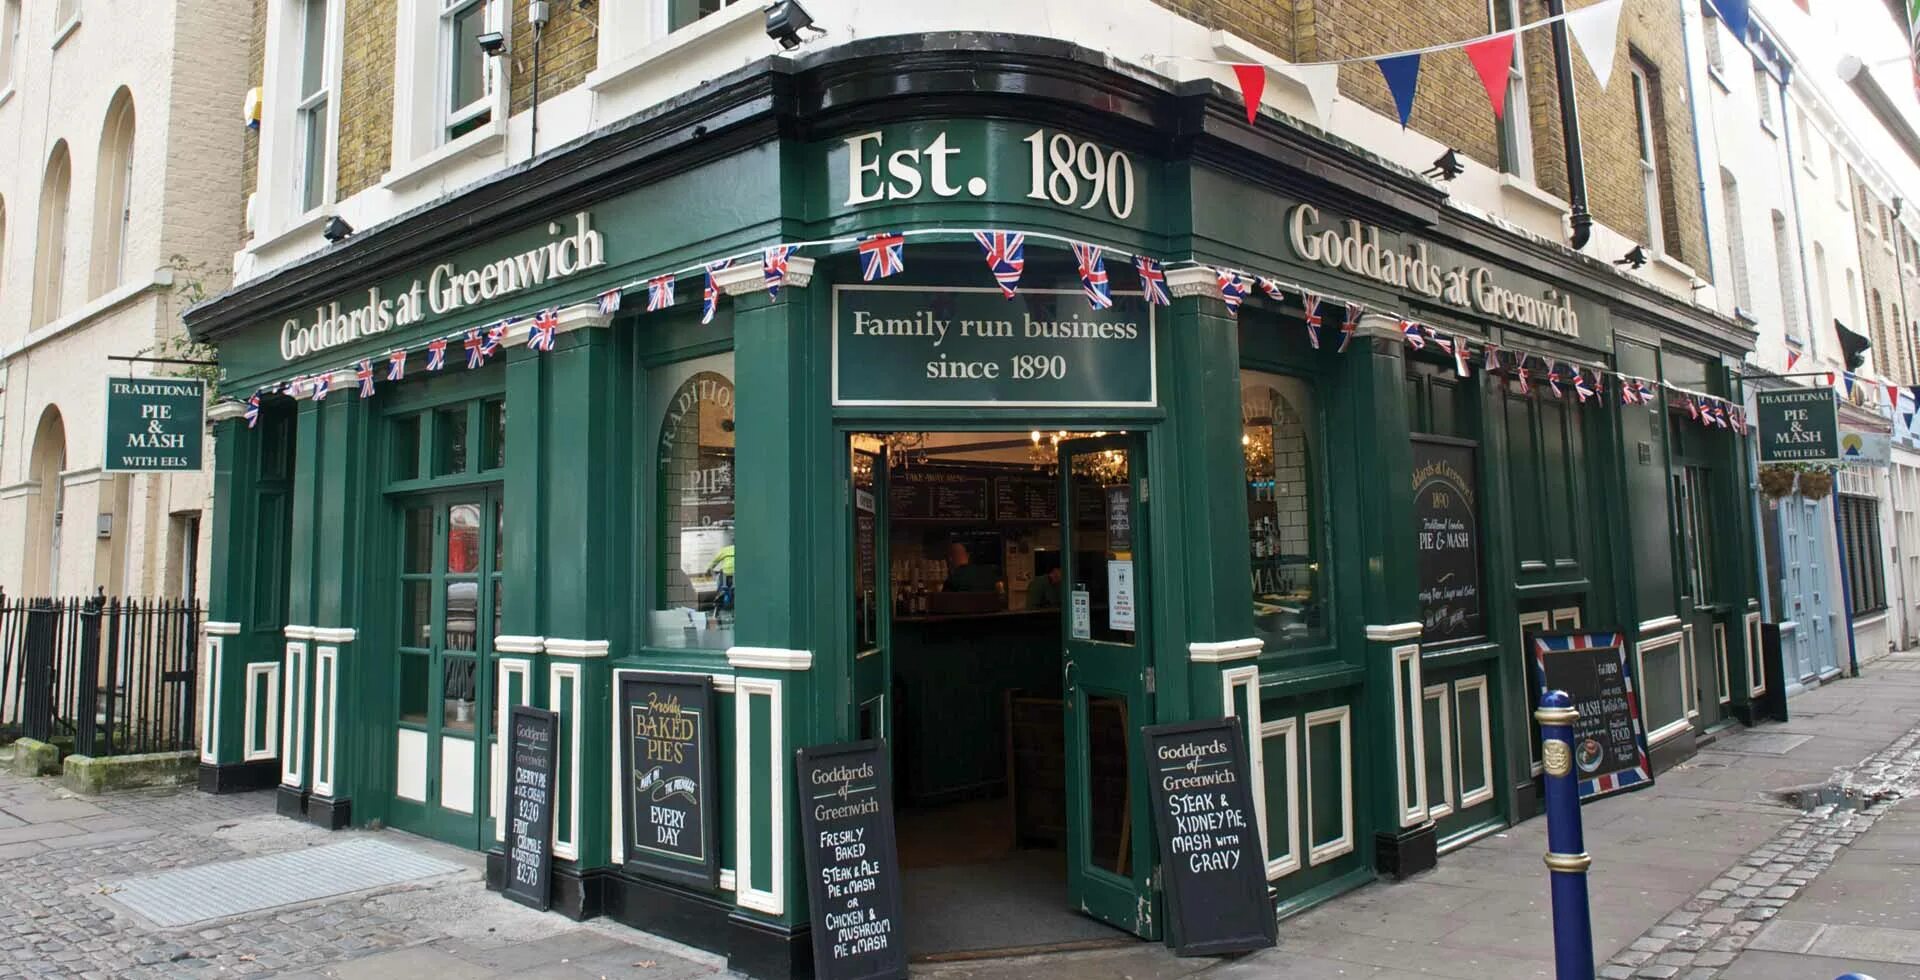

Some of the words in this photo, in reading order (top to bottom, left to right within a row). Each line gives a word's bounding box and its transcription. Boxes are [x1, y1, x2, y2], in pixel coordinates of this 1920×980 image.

[844, 131, 988, 208] Est.
[1023, 128, 1135, 220] 1890
[1288, 203, 1444, 299] Goddards
[1444, 266, 1472, 308] at
[1472, 267, 1580, 339] Greenwich
[280, 287, 393, 361] Goddards
[396, 280, 425, 326] at
[428, 211, 606, 315] Greenwich
[853, 311, 951, 347] Family
[960, 318, 1013, 338] run
[1023, 313, 1138, 341] business
[926, 355, 999, 381] since
[1011, 355, 1067, 382] 1890
[112, 383, 201, 397] TRADITIONAL
[1758, 391, 1832, 404] TRADITIONAL
[141, 404, 172, 419] PIE
[1784, 408, 1809, 421] PIE
[147, 419, 164, 434] &
[1775, 431, 1822, 444] MASH
[1790, 421, 1803, 433] &
[126, 433, 185, 448] MASH
[122, 456, 158, 466] WITH
[160, 456, 188, 467] EELS
[1772, 450, 1801, 458] WITH
[1803, 448, 1827, 457] EELS
[1419, 532, 1435, 550] PIE
[1436, 531, 1446, 551] &
[1446, 532, 1469, 549] MASH
[516, 723, 549, 742] Goddards
[637, 714, 694, 740] BAKED
[1612, 728, 1630, 742] FOOD
[515, 751, 547, 768] Greenwich
[647, 740, 683, 764] PIES
[1158, 739, 1228, 761] Goddards
[516, 766, 539, 786] CHERRY
[538, 772, 547, 789] PIE
[811, 762, 874, 784] Goddards
[1162, 768, 1237, 791] Greenwich
[527, 786, 546, 805] CREAM
[1168, 792, 1215, 816] STEAK
[1221, 793, 1229, 808] &
[650, 805, 686, 829] EVERY
[815, 796, 879, 821] Greenwich
[512, 818, 529, 838] FRUIT
[1176, 811, 1224, 835] KIDNEY
[1226, 808, 1248, 829] PIE,
[517, 834, 542, 855] CRUMBLE
[657, 825, 680, 846] DAY
[820, 826, 864, 849] FRESHLY
[1171, 832, 1212, 854] MASH
[1215, 834, 1239, 847] WITH
[516, 848, 540, 868] CUSTARD
[835, 843, 866, 862] BAKED
[1189, 849, 1241, 874] GRAVY
[822, 866, 852, 884] STEAK
[853, 865, 861, 878] &
[861, 859, 880, 877] ALE
[828, 884, 842, 899] PIE
[843, 886, 849, 895] &
[849, 877, 875, 894] MASH
[825, 909, 864, 931] CHICKEN
[869, 907, 876, 921] &
[838, 918, 891, 943] MUSHROOM
[833, 942, 848, 959] PIE
[851, 945, 857, 955] &
[857, 934, 888, 953] MASH
